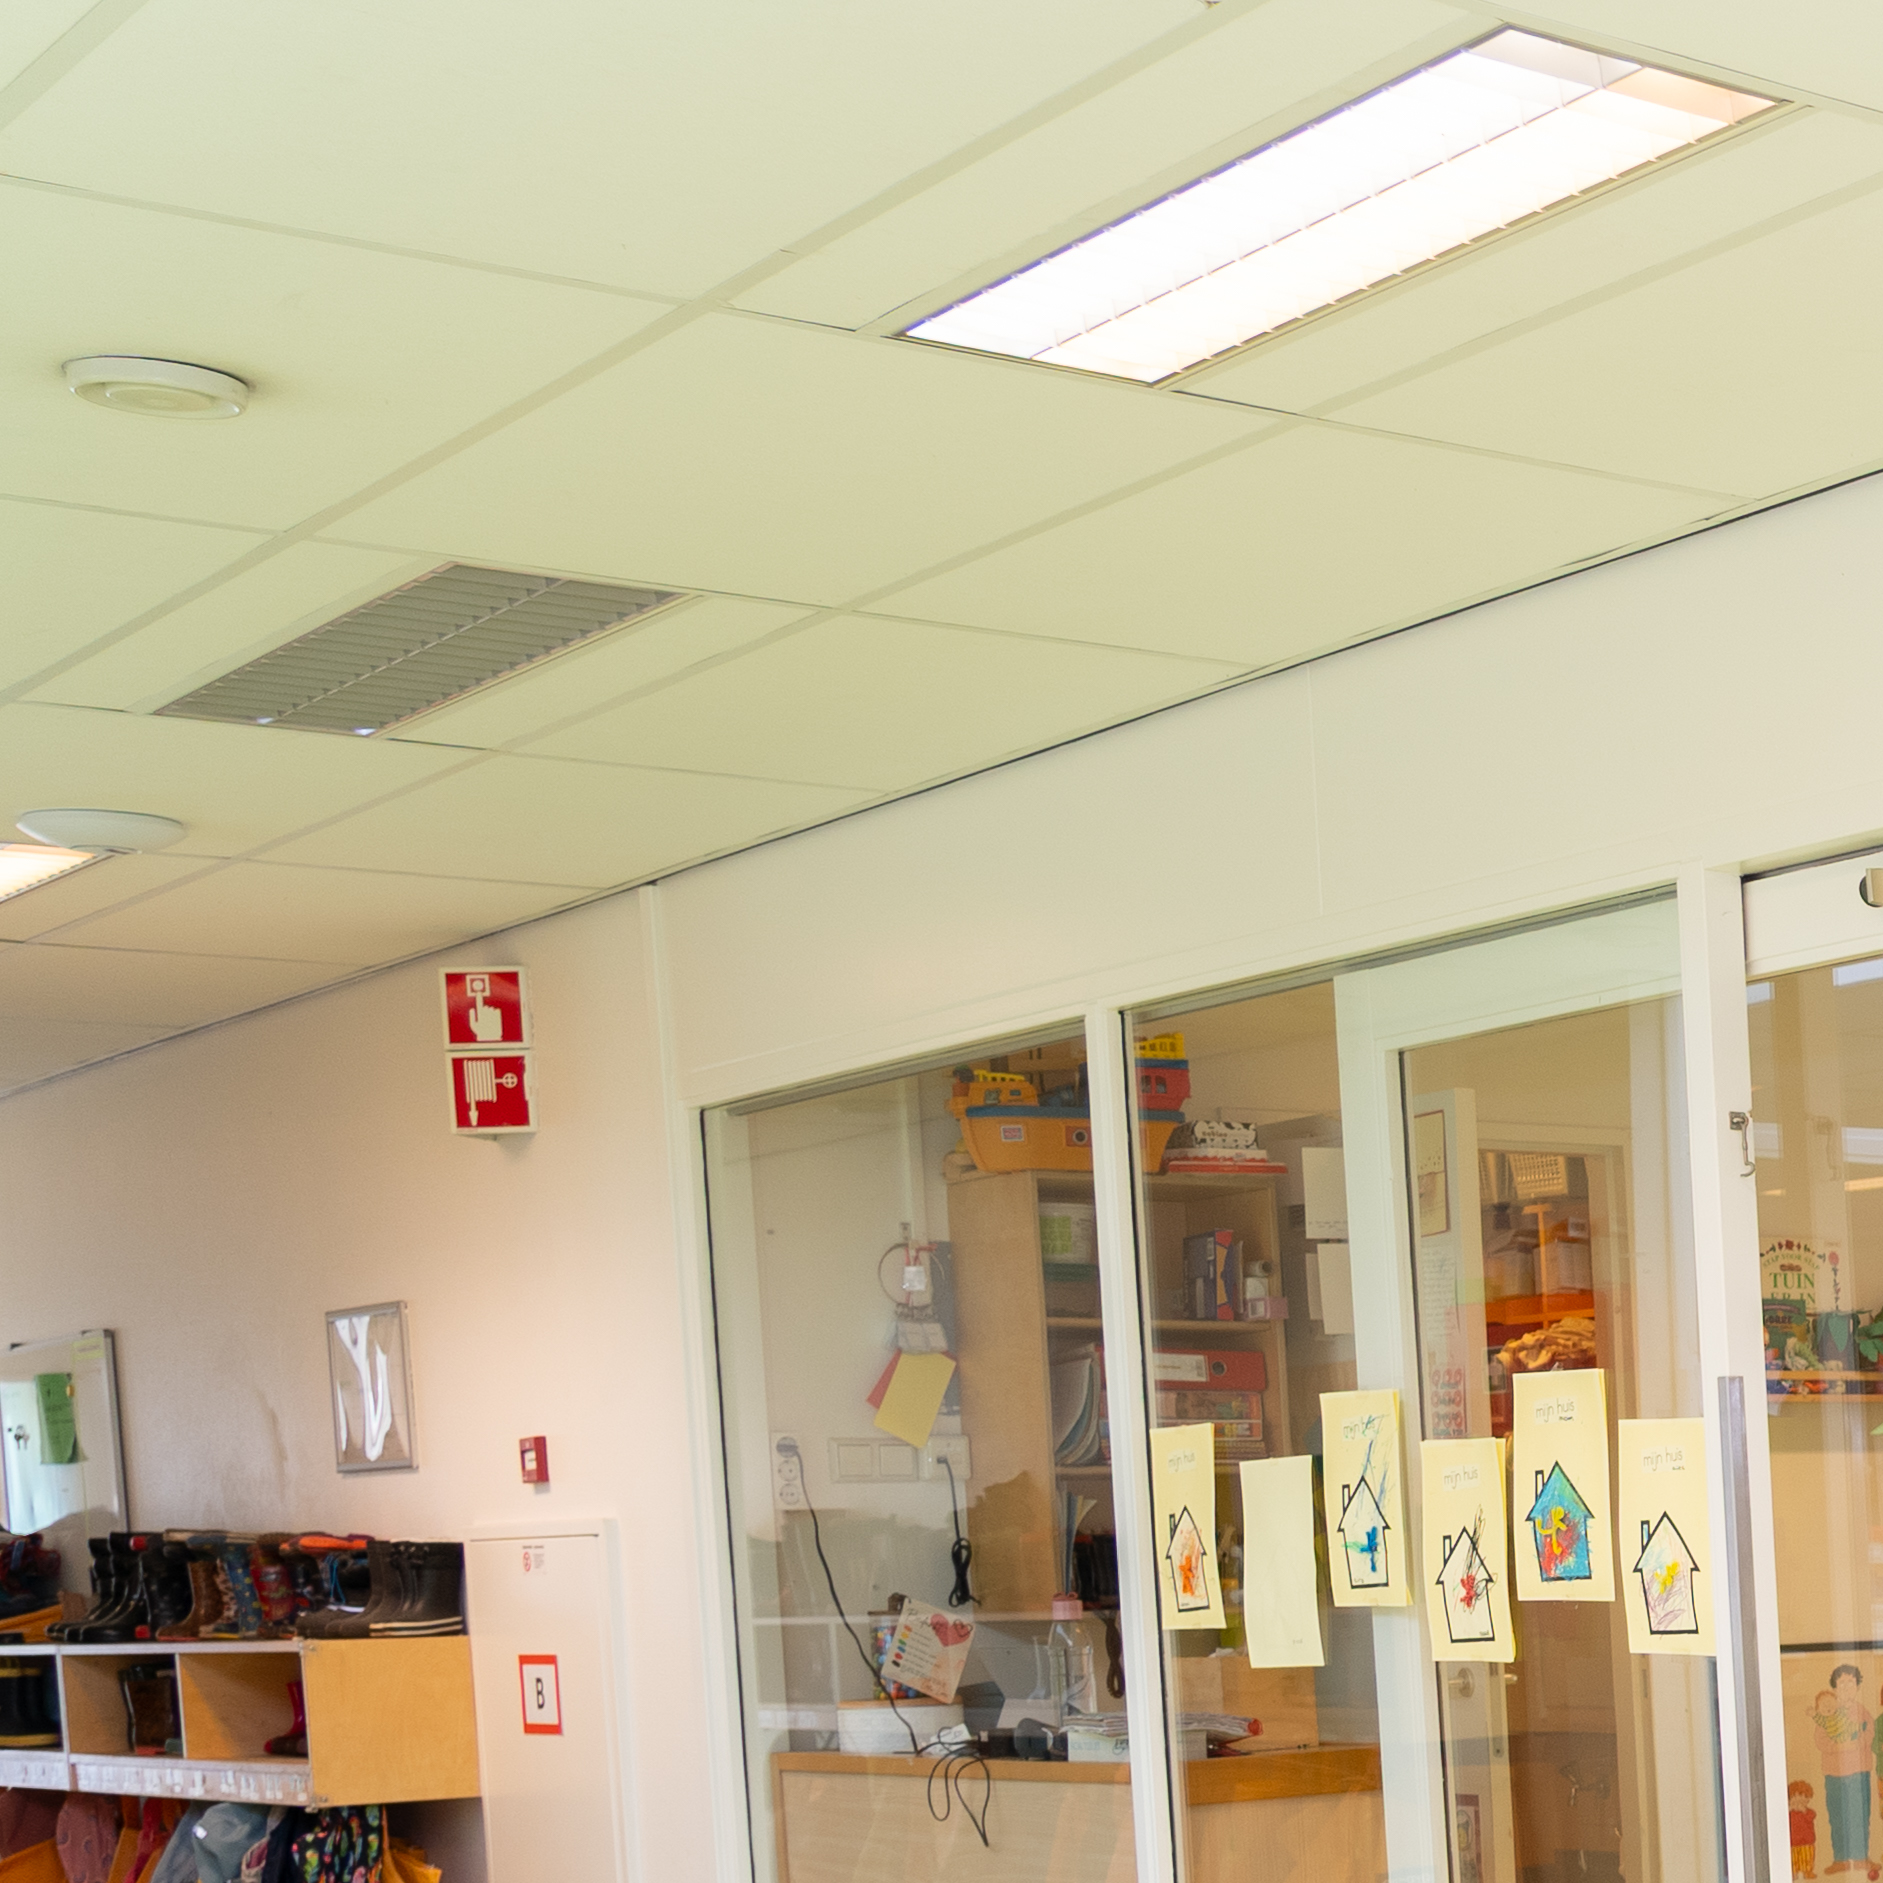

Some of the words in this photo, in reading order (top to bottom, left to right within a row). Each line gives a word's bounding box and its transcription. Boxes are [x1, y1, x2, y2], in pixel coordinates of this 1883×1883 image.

[1769, 1272, 1815, 1290] TUIN
[1535, 1403, 1554, 1423] mijn
[1556, 1397, 1575, 1414] huis
[1643, 1452, 1663, 1471] mijn
[535, 1677, 545, 1710] B
